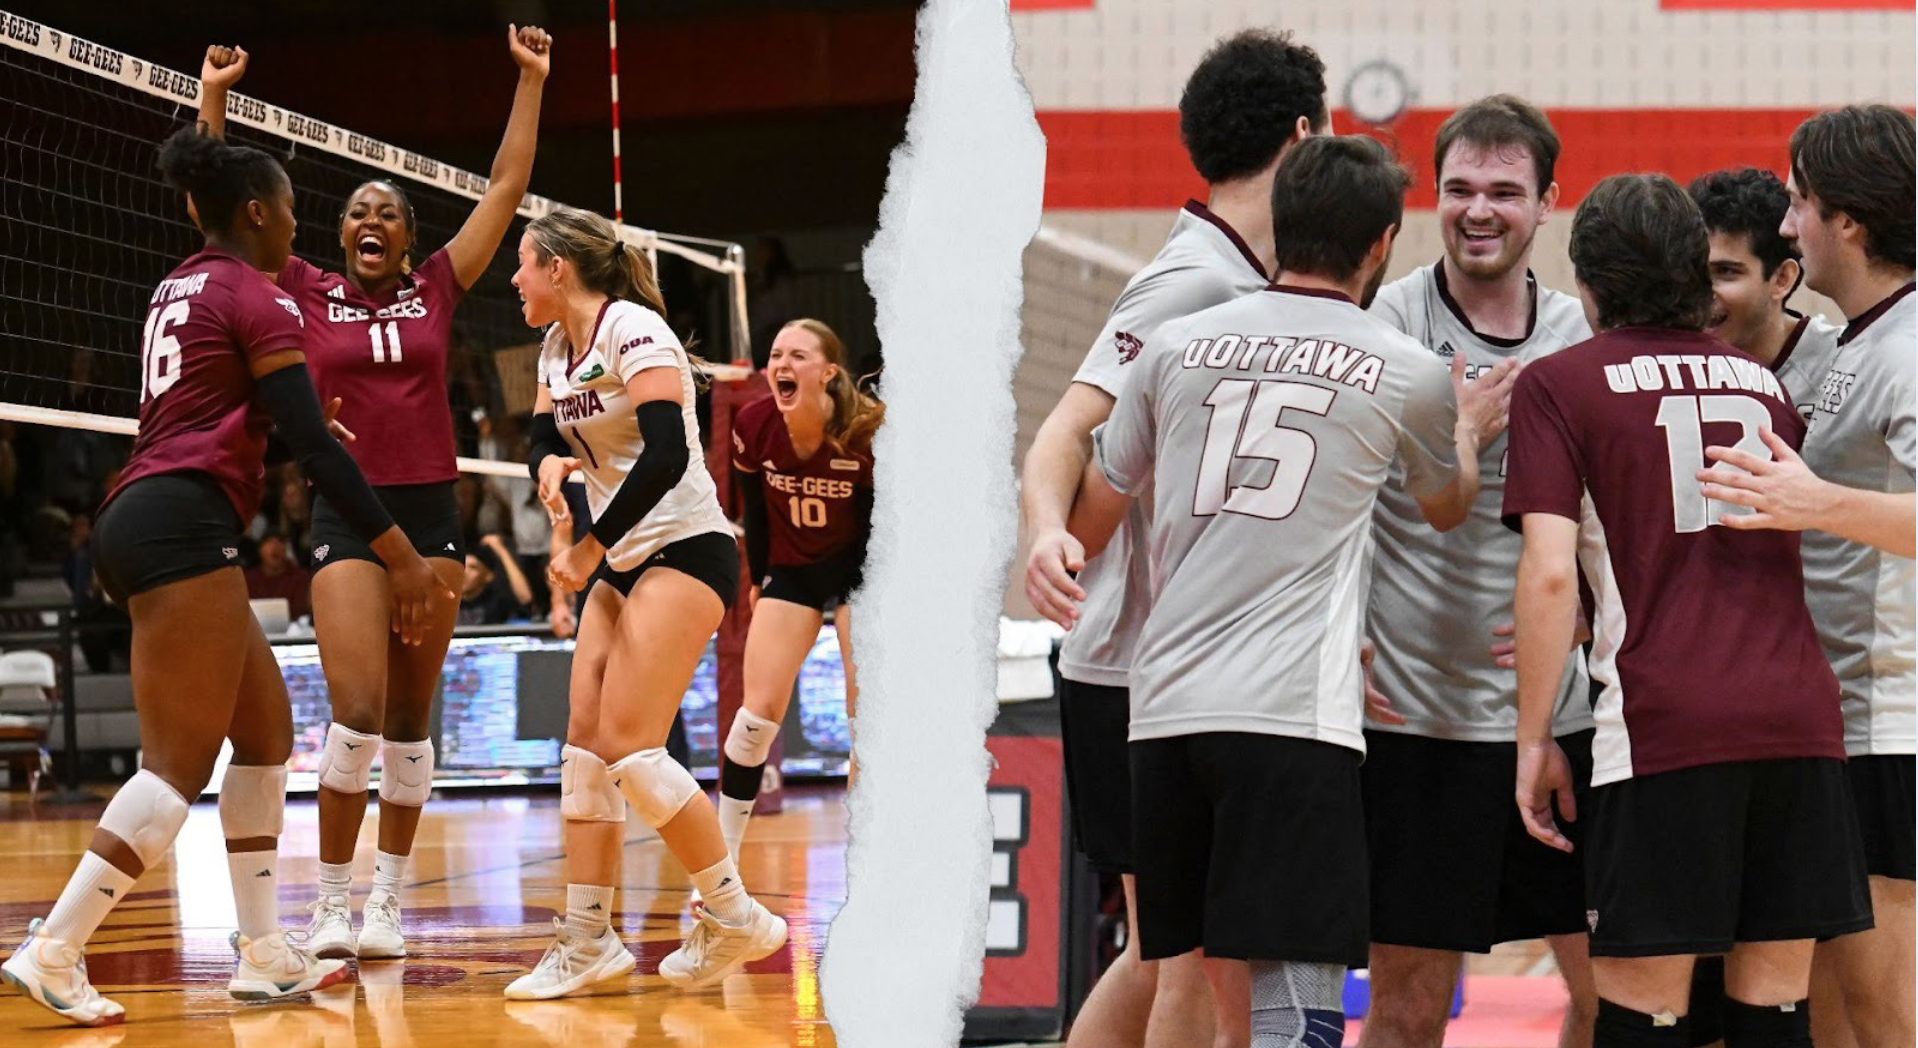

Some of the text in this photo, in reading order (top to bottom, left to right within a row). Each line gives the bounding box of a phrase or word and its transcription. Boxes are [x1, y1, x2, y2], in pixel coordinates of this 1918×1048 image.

[68, 38, 124, 75] GEE-GEES
[149, 65, 198, 100] GEE-GEES
[227, 92, 267, 124] EE-GEES
[287, 115, 330, 144] GEE-GEES
[140, 299, 190, 404] 16
[368, 320, 403, 363] 11
[571, 425, 600, 469] 1
[1192, 377, 1339, 521] 15
[788, 495, 828, 529] 10
